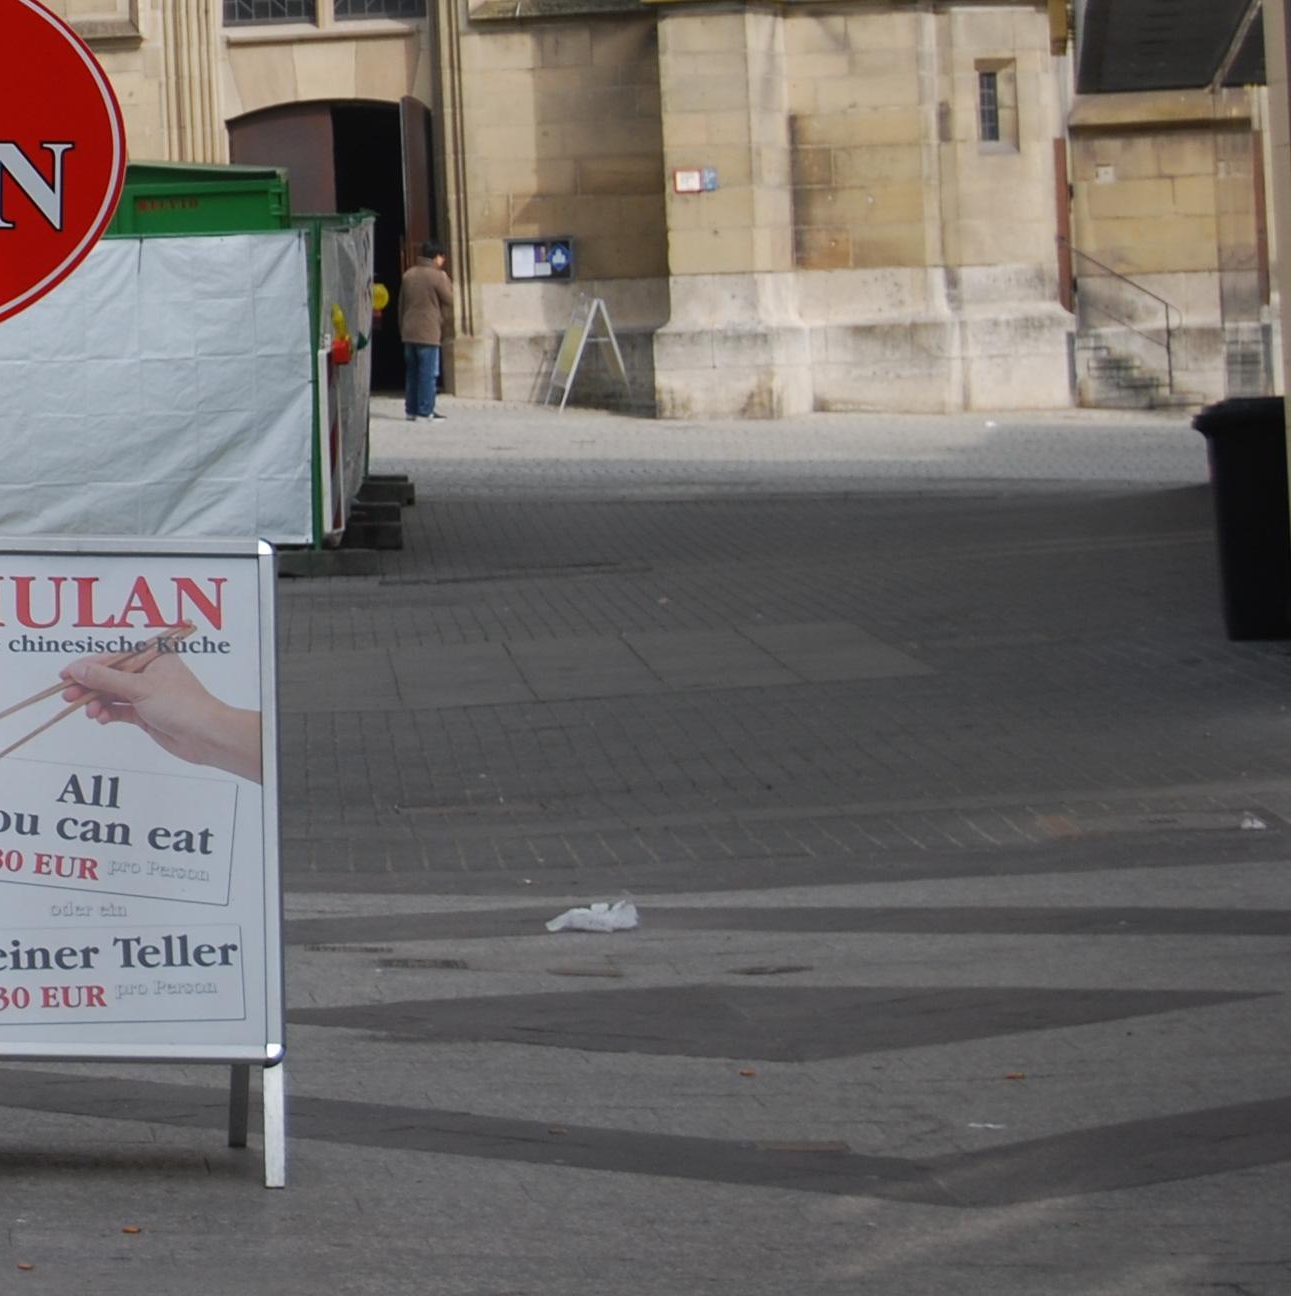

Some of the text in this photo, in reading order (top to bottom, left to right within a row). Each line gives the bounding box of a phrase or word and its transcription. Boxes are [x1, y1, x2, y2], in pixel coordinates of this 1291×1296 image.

[8, 634, 148, 654] chinesische
[156, 634, 231, 654] Küche
[56, 773, 120, 808] All
[55, 816, 132, 847] can
[148, 821, 215, 856] eat
[33, 854, 100, 881] EUR
[113, 935, 238, 968] Teller
[41, 986, 107, 1008] EUR
